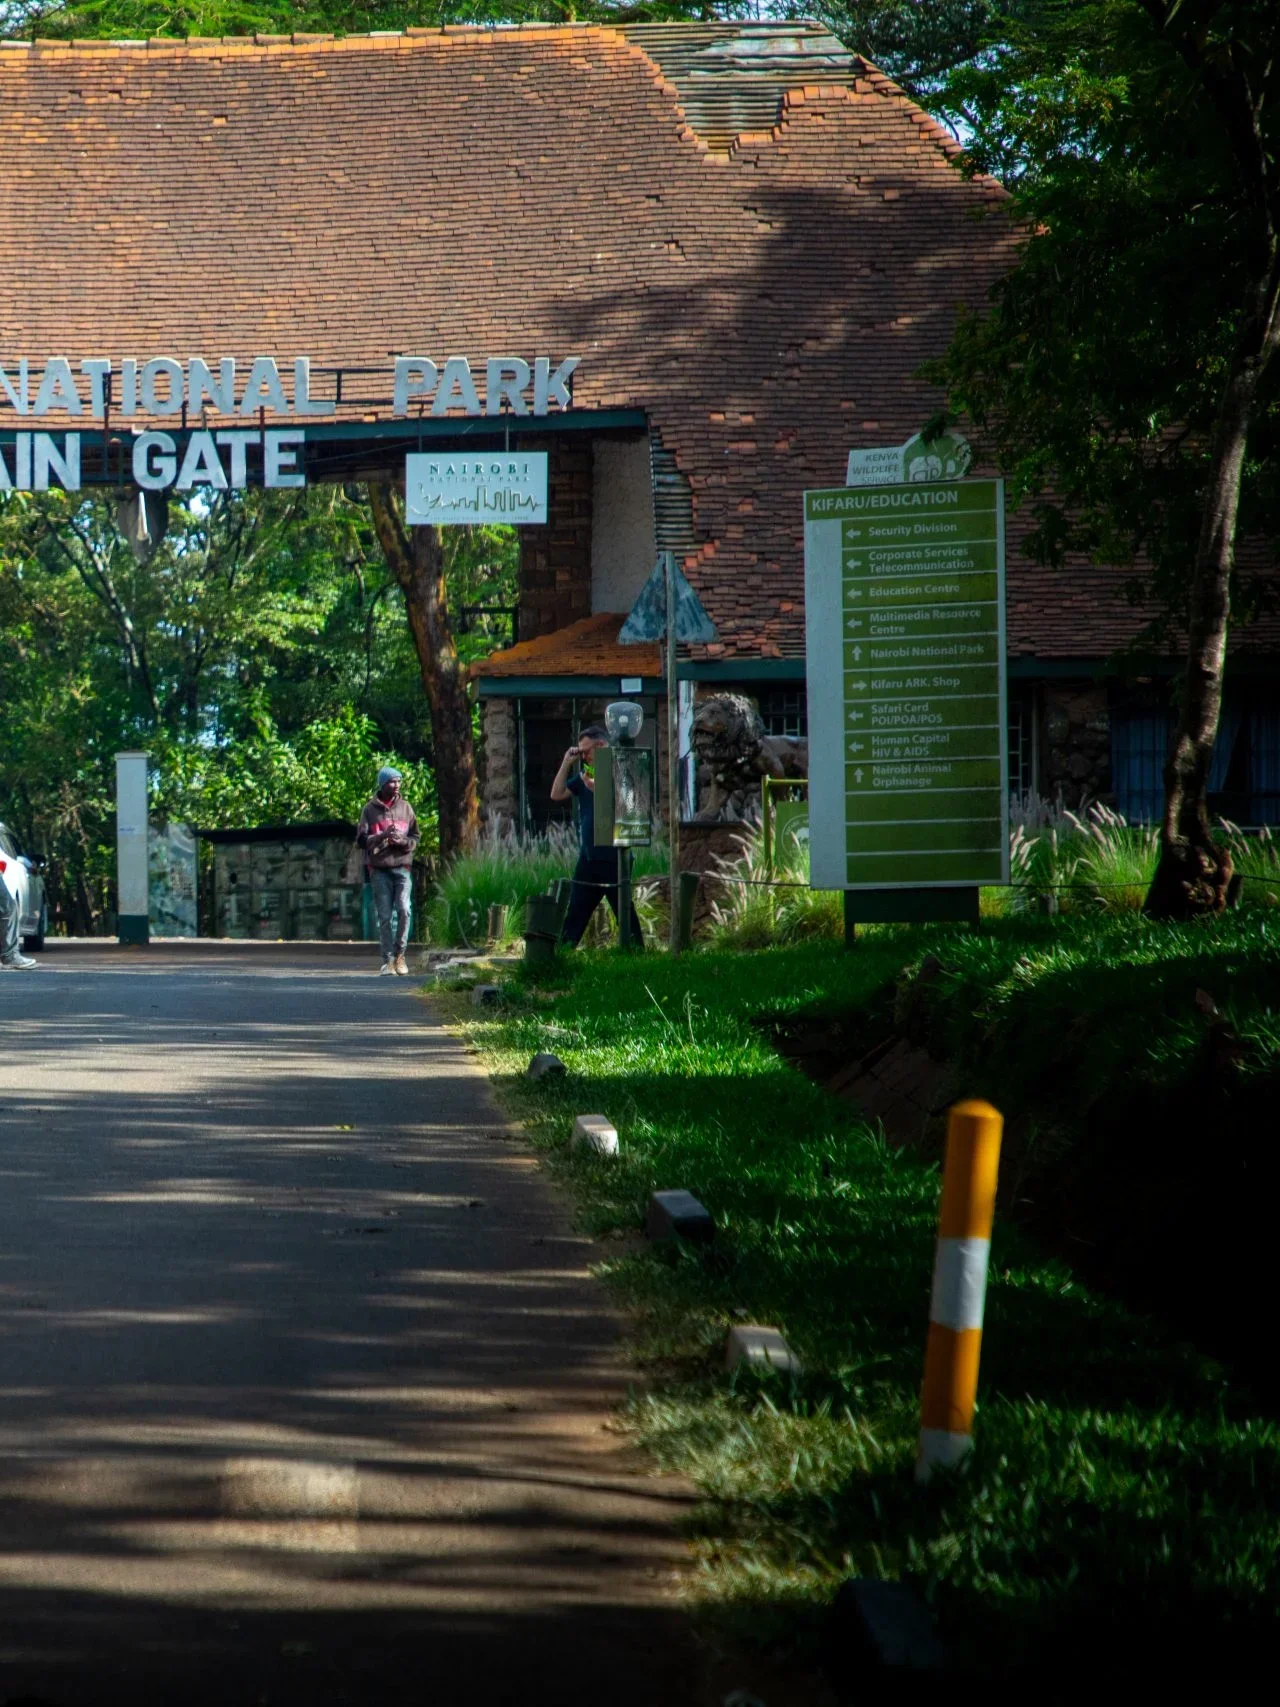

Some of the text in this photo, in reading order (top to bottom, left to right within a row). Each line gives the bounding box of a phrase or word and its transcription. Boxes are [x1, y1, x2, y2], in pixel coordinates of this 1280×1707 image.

[393, 356, 582, 416] PARK
[132, 430, 306, 490] GATE
[865, 452, 898, 462] KENYA
[429, 463, 529, 475] NAIROBI
[852, 464, 899, 475] WILDLIFE
[811, 490, 959, 512] KIFARU/EDUCATION
[868, 523, 958, 537] Security Division
[868, 547, 969, 562] Corporate Services
[869, 559, 975, 573] Telecommunication
[869, 584, 960, 597] Education Centre
[870, 609, 981, 622] Multimedia Resource
[870, 625, 905, 635] Centre
[870, 644, 985, 659] Nairobi National Park
[871, 679, 903, 690] Kifaru
[932, 676, 961, 688] Shop
[871, 702, 929, 714] Safari Card
[871, 733, 950, 746] Human Capital
[871, 746, 930, 758] HIV & AIDS
[872, 763, 952, 775] Nairobi Animal
[872, 777, 932, 788] Orphanage
